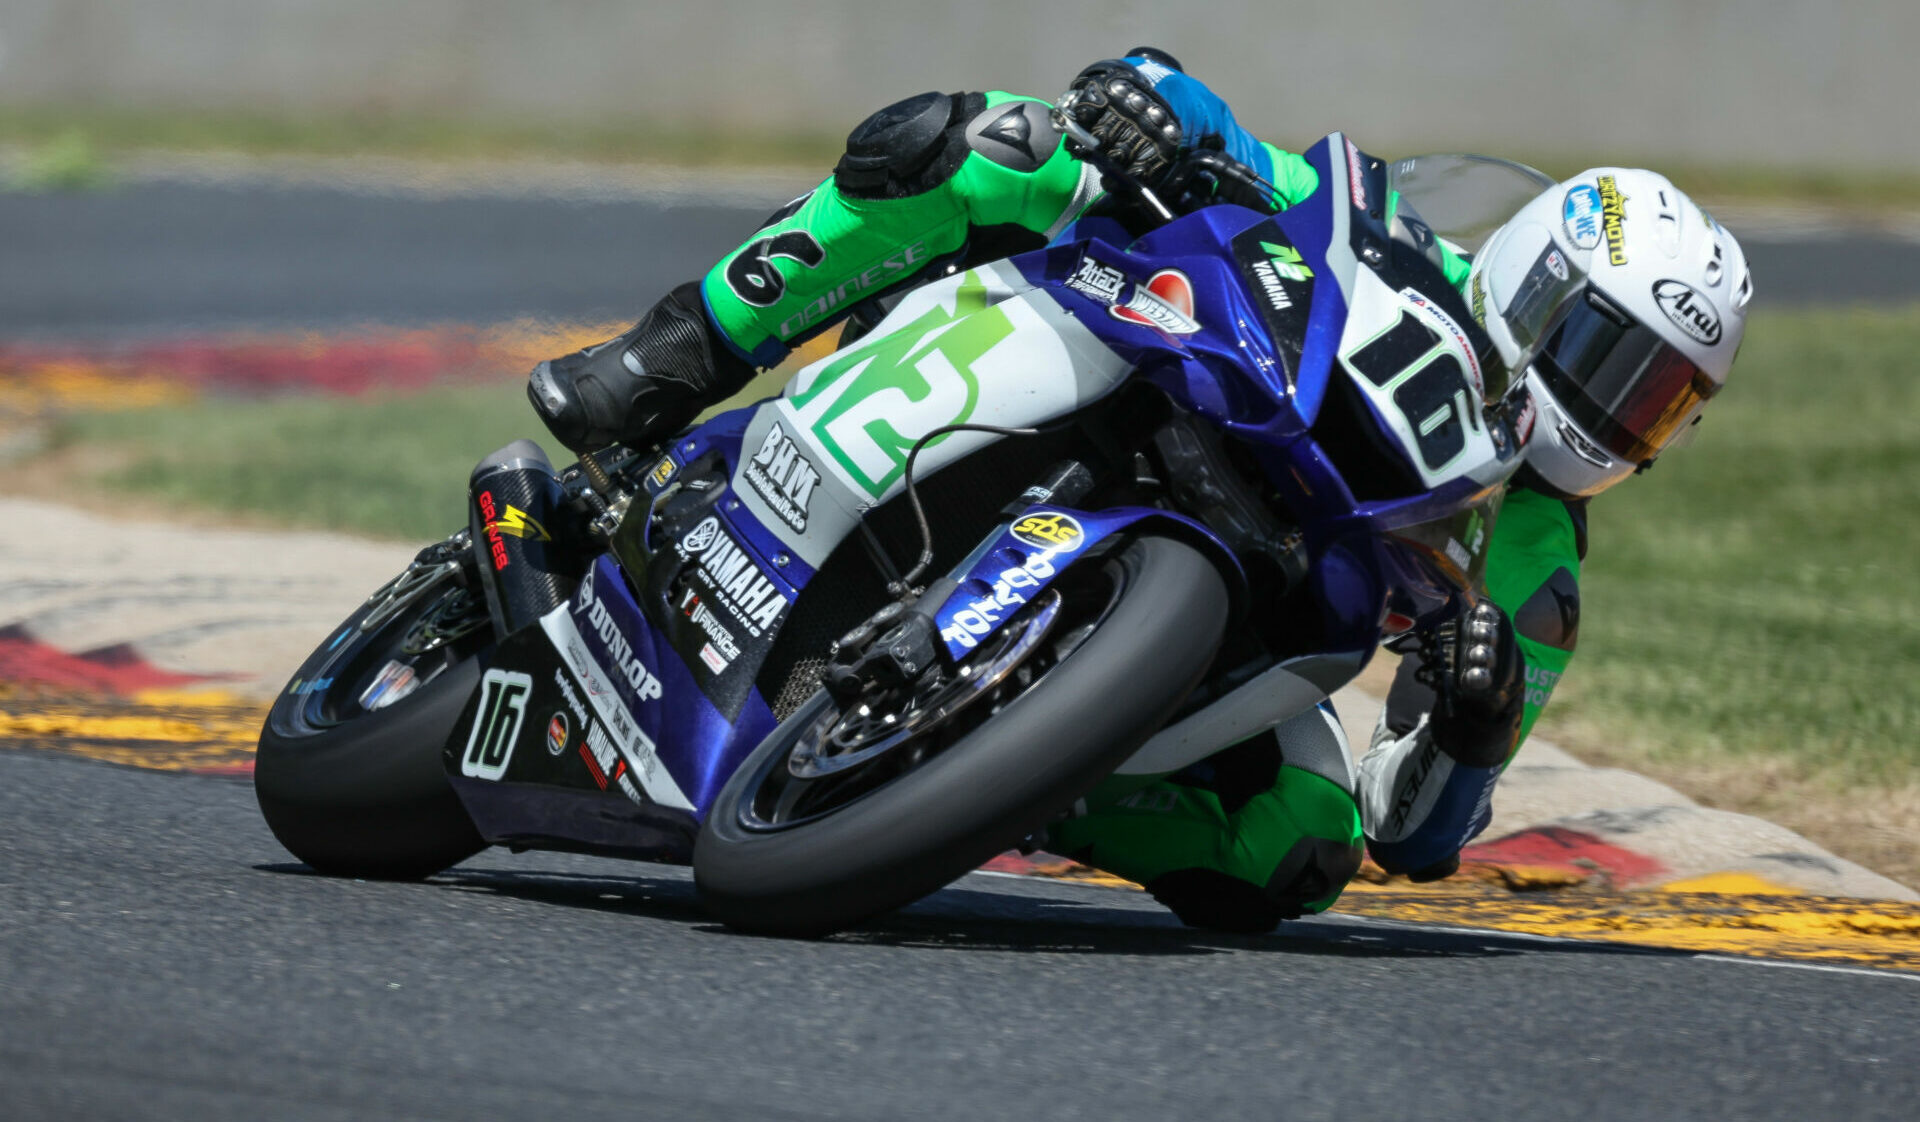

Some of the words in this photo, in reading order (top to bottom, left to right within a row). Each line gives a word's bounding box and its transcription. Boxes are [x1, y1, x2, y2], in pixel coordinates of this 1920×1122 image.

[780, 241, 927, 336] DAINESE
[1080, 256, 1127, 302] Attack
[1252, 260, 1292, 310] YAMAHA
[1259, 241, 1315, 282] N2
[1427, 307, 1485, 394] MOTOAMERICA
[1657, 288, 1720, 338] Arai
[1347, 306, 1480, 474] 16
[752, 421, 820, 515] BHM
[480, 491, 508, 570] GRAVES
[1014, 516, 1079, 545] sbs
[700, 529, 788, 630] YAMAHA
[715, 590, 760, 637] RACING
[587, 597, 663, 701] DUNLOP
[699, 613, 741, 661] FINANCE
[465, 673, 529, 777] 16
